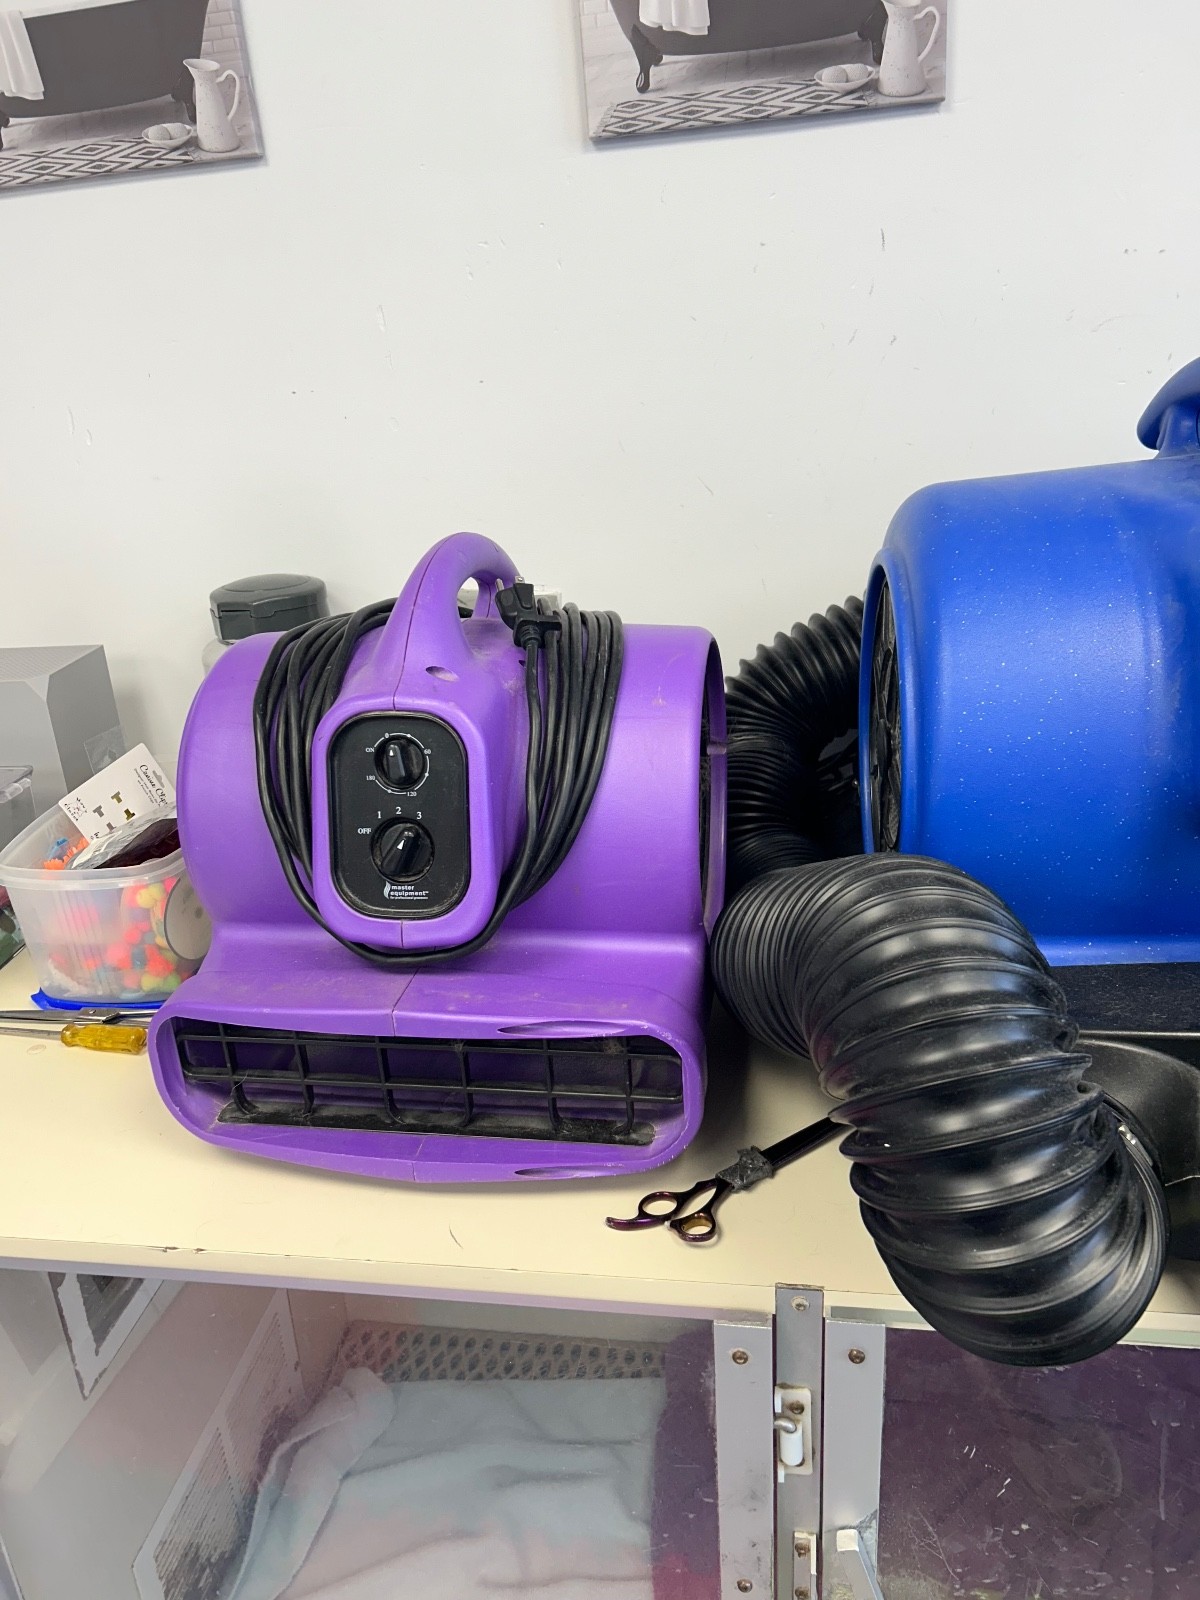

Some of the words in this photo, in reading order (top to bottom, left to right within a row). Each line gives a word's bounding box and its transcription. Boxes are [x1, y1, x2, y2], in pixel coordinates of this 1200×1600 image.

[377, 811, 382, 819] 1
[395, 806, 402, 815] 2
[416, 811, 422, 820] 3
[357, 827, 372, 835] OFF
